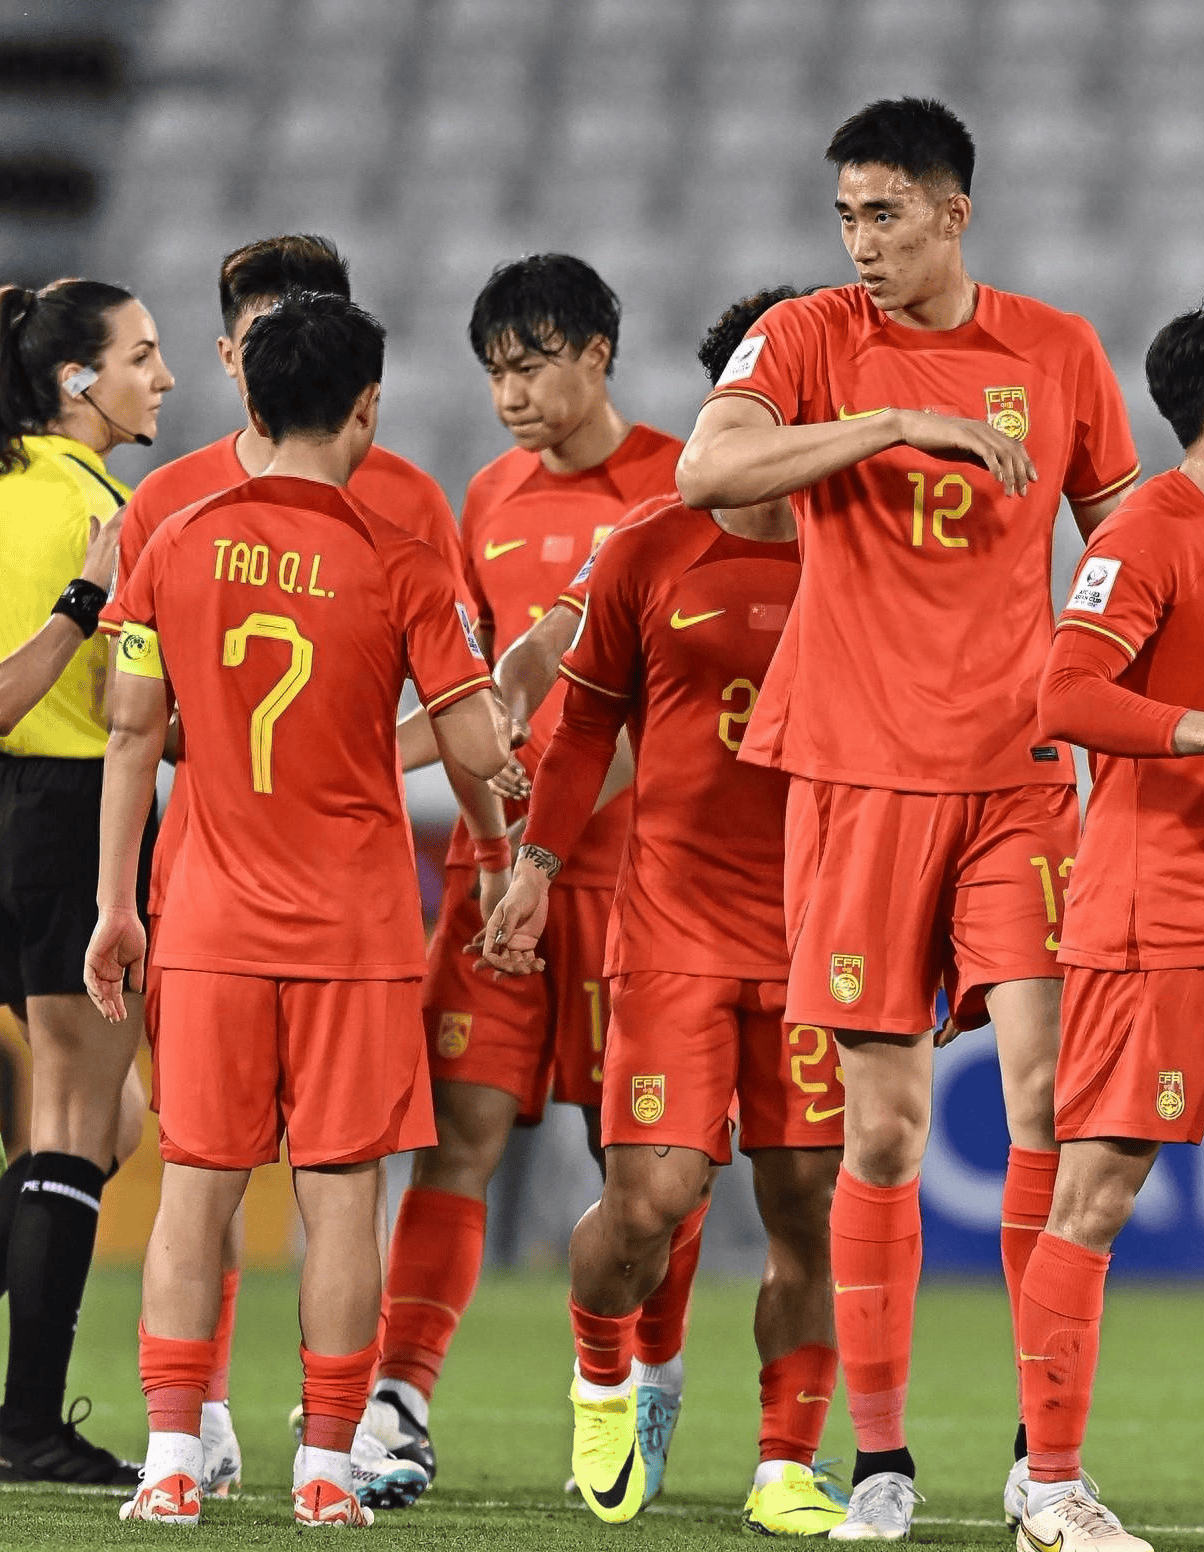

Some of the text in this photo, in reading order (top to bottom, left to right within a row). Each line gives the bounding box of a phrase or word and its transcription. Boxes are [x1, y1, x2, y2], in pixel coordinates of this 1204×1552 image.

[989, 390, 1023, 402] CFA
[907, 472, 972, 548] 12
[213, 539, 270, 586] TAO
[222, 612, 314, 794] 7
[834, 957, 861, 969] CFA
[788, 1024, 846, 1093] 2
[635, 1079, 662, 1088] CFA
